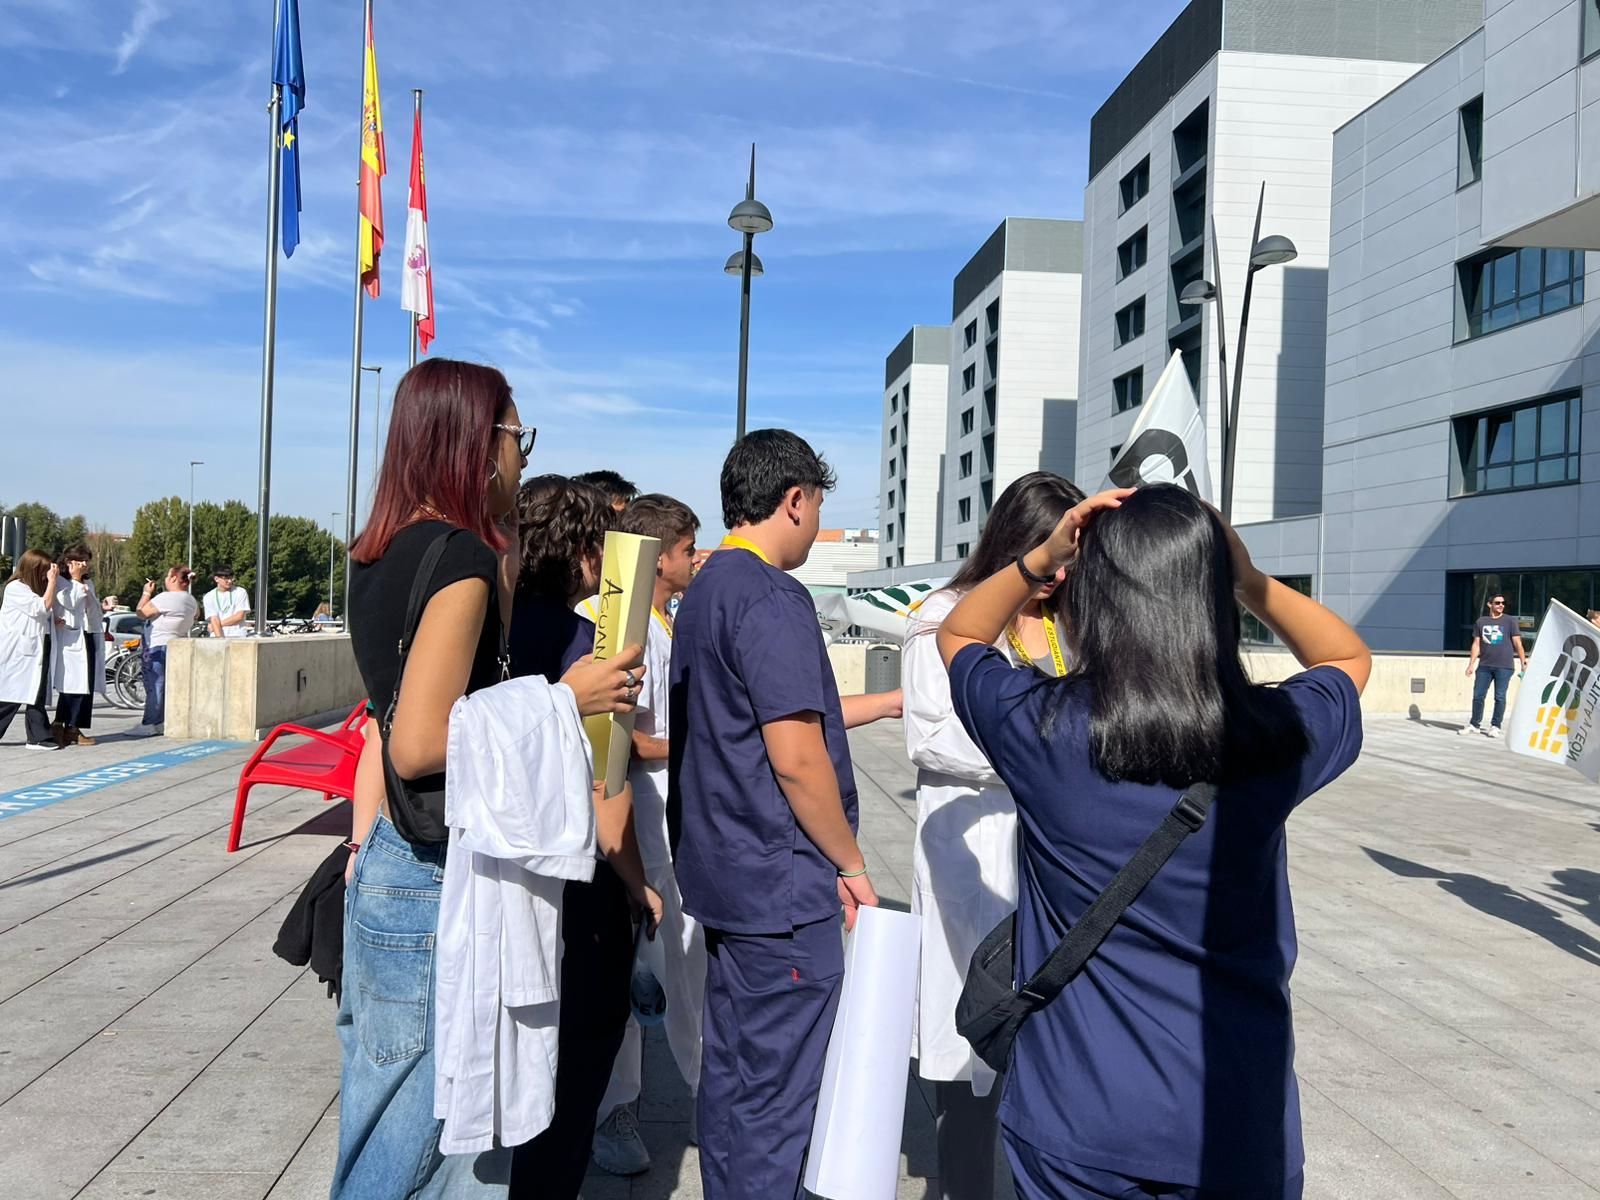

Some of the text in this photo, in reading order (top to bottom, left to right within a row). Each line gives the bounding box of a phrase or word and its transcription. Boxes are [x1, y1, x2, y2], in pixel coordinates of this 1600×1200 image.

[671, 599, 679, 608] P
[1046, 626, 1063, 669] ESTUDIANTE
[13, 761, 165, 800] RECINTO
